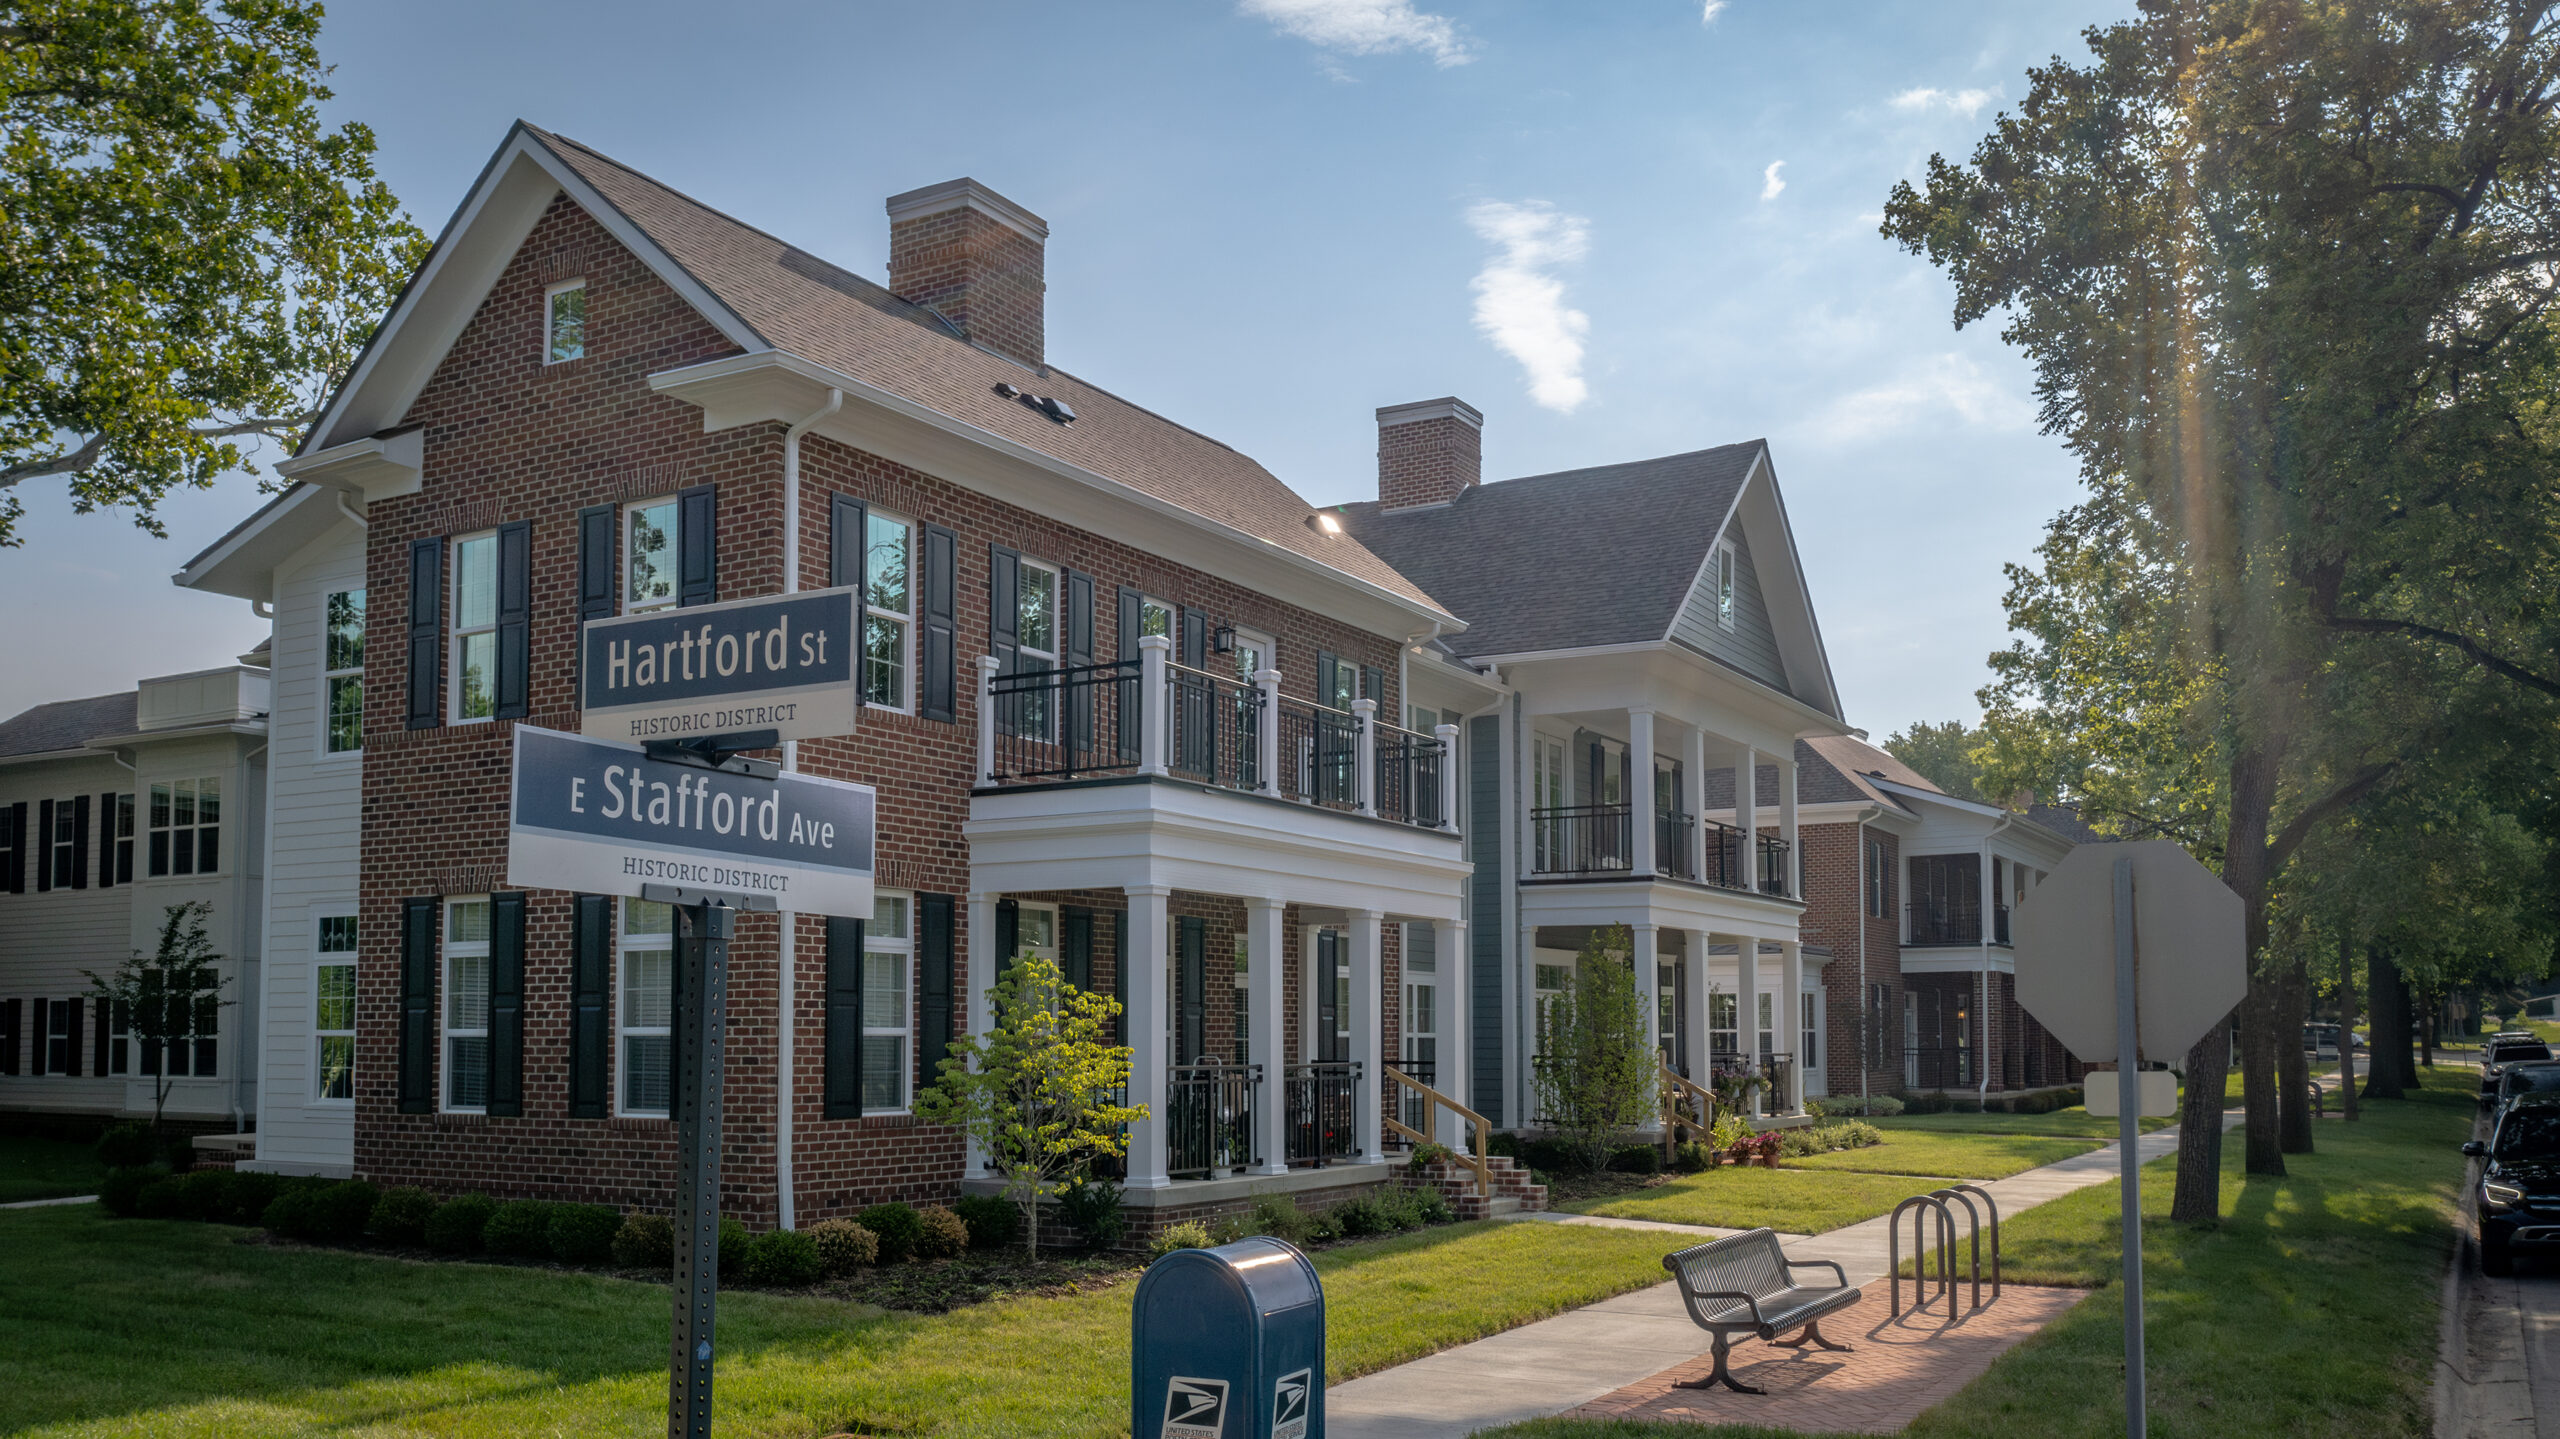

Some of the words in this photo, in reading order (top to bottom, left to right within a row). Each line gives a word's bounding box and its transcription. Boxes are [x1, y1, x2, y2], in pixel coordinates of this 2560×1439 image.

[608, 614, 788, 689] Hartford
[799, 629, 828, 667] St
[630, 711, 711, 737] HISTORIC
[716, 703, 798, 729] DISTRICT
[570, 776, 586, 814] E
[601, 764, 780, 842] Stafford
[788, 812, 836, 849] Ave
[622, 856, 709, 883] HISTORIC
[713, 867, 790, 893] DISTRICT
[1166, 1427, 1190, 1435] UNITED
[1191, 1429, 1215, 1438] STATES
